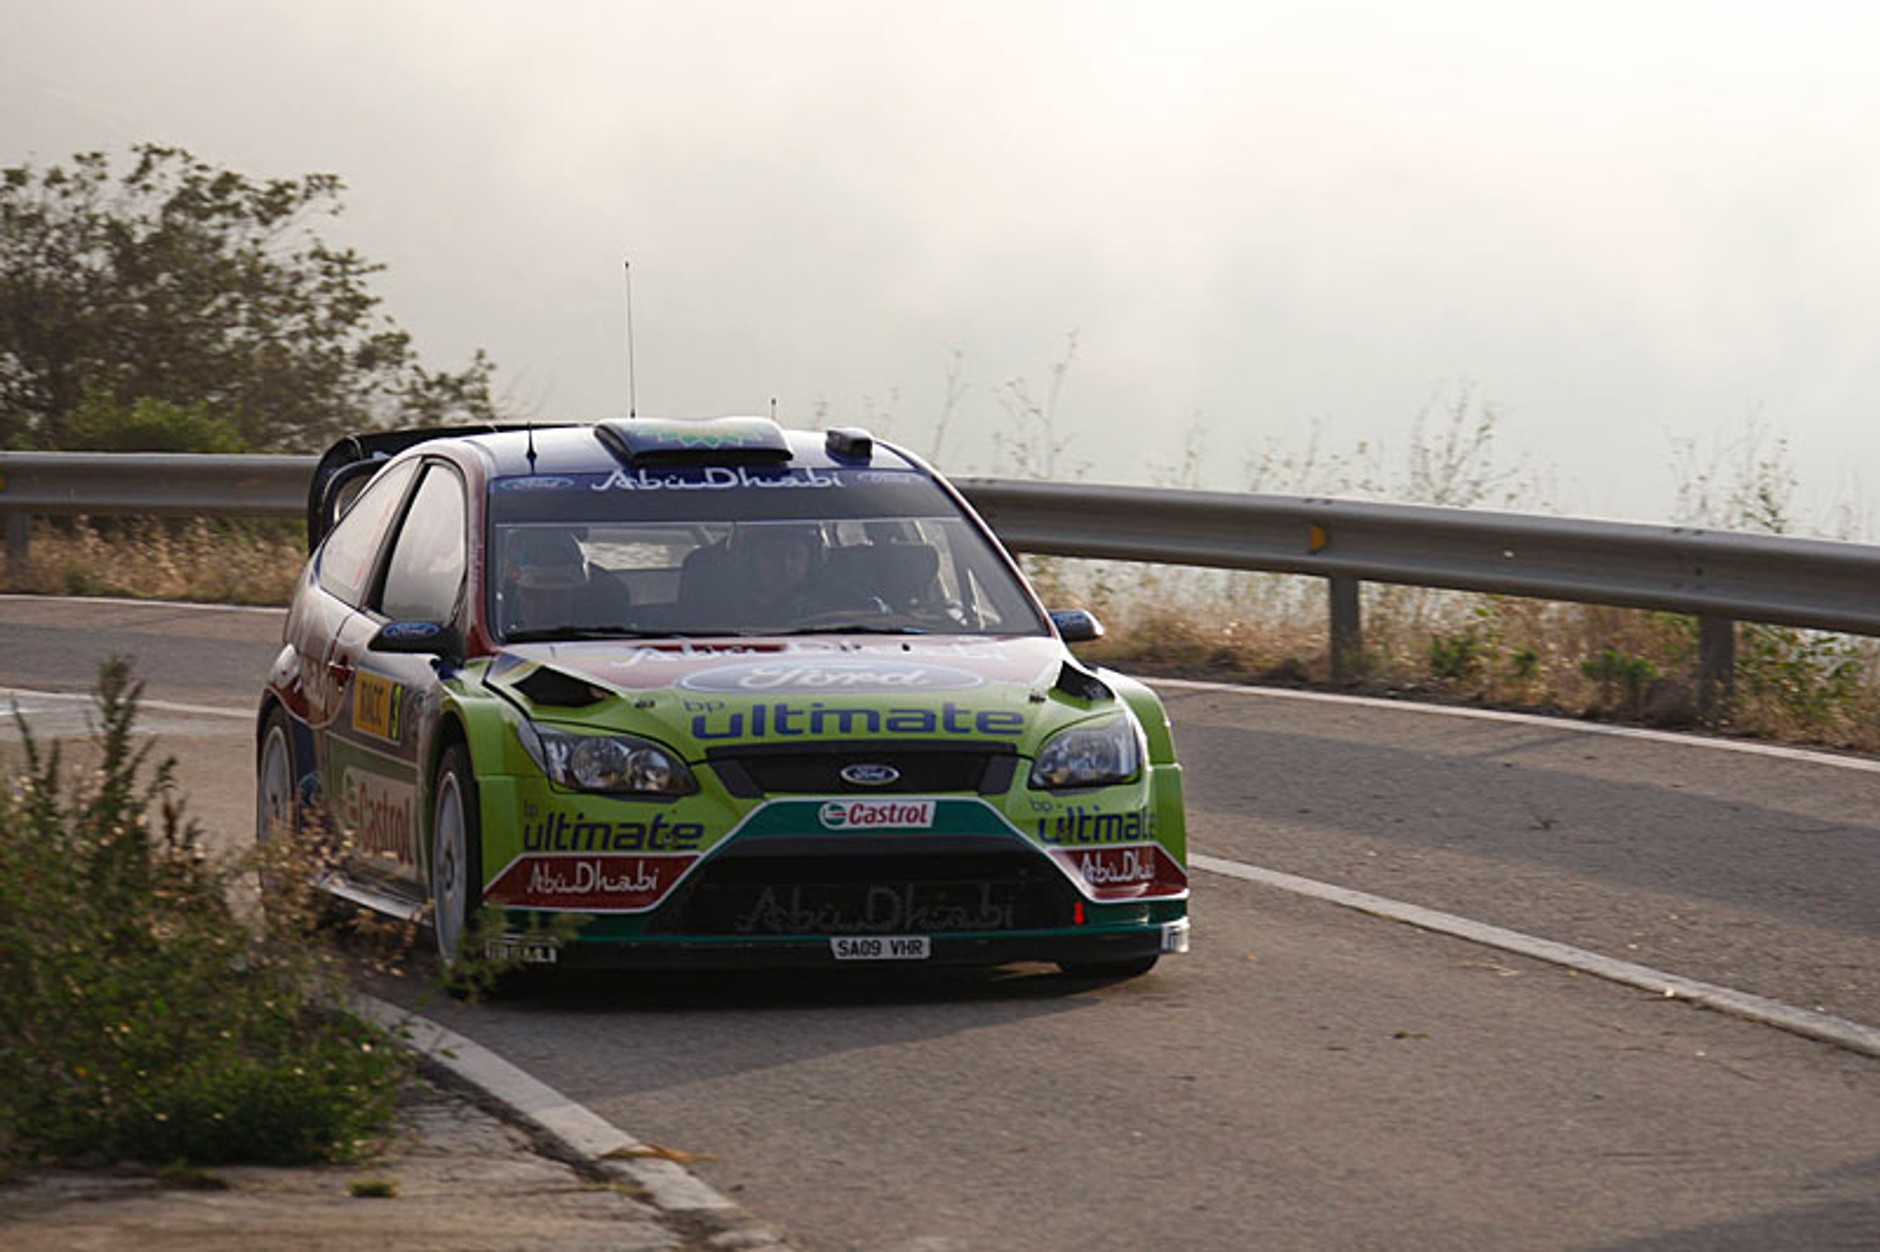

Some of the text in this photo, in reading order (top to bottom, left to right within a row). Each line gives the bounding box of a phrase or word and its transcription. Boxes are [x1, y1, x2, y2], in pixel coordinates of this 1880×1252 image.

[691, 702, 1025, 740] ultimate
[849, 804, 928, 825] Castrol
[523, 812, 705, 851] ultimate
[837, 939, 924, 958] SA09 VHR
